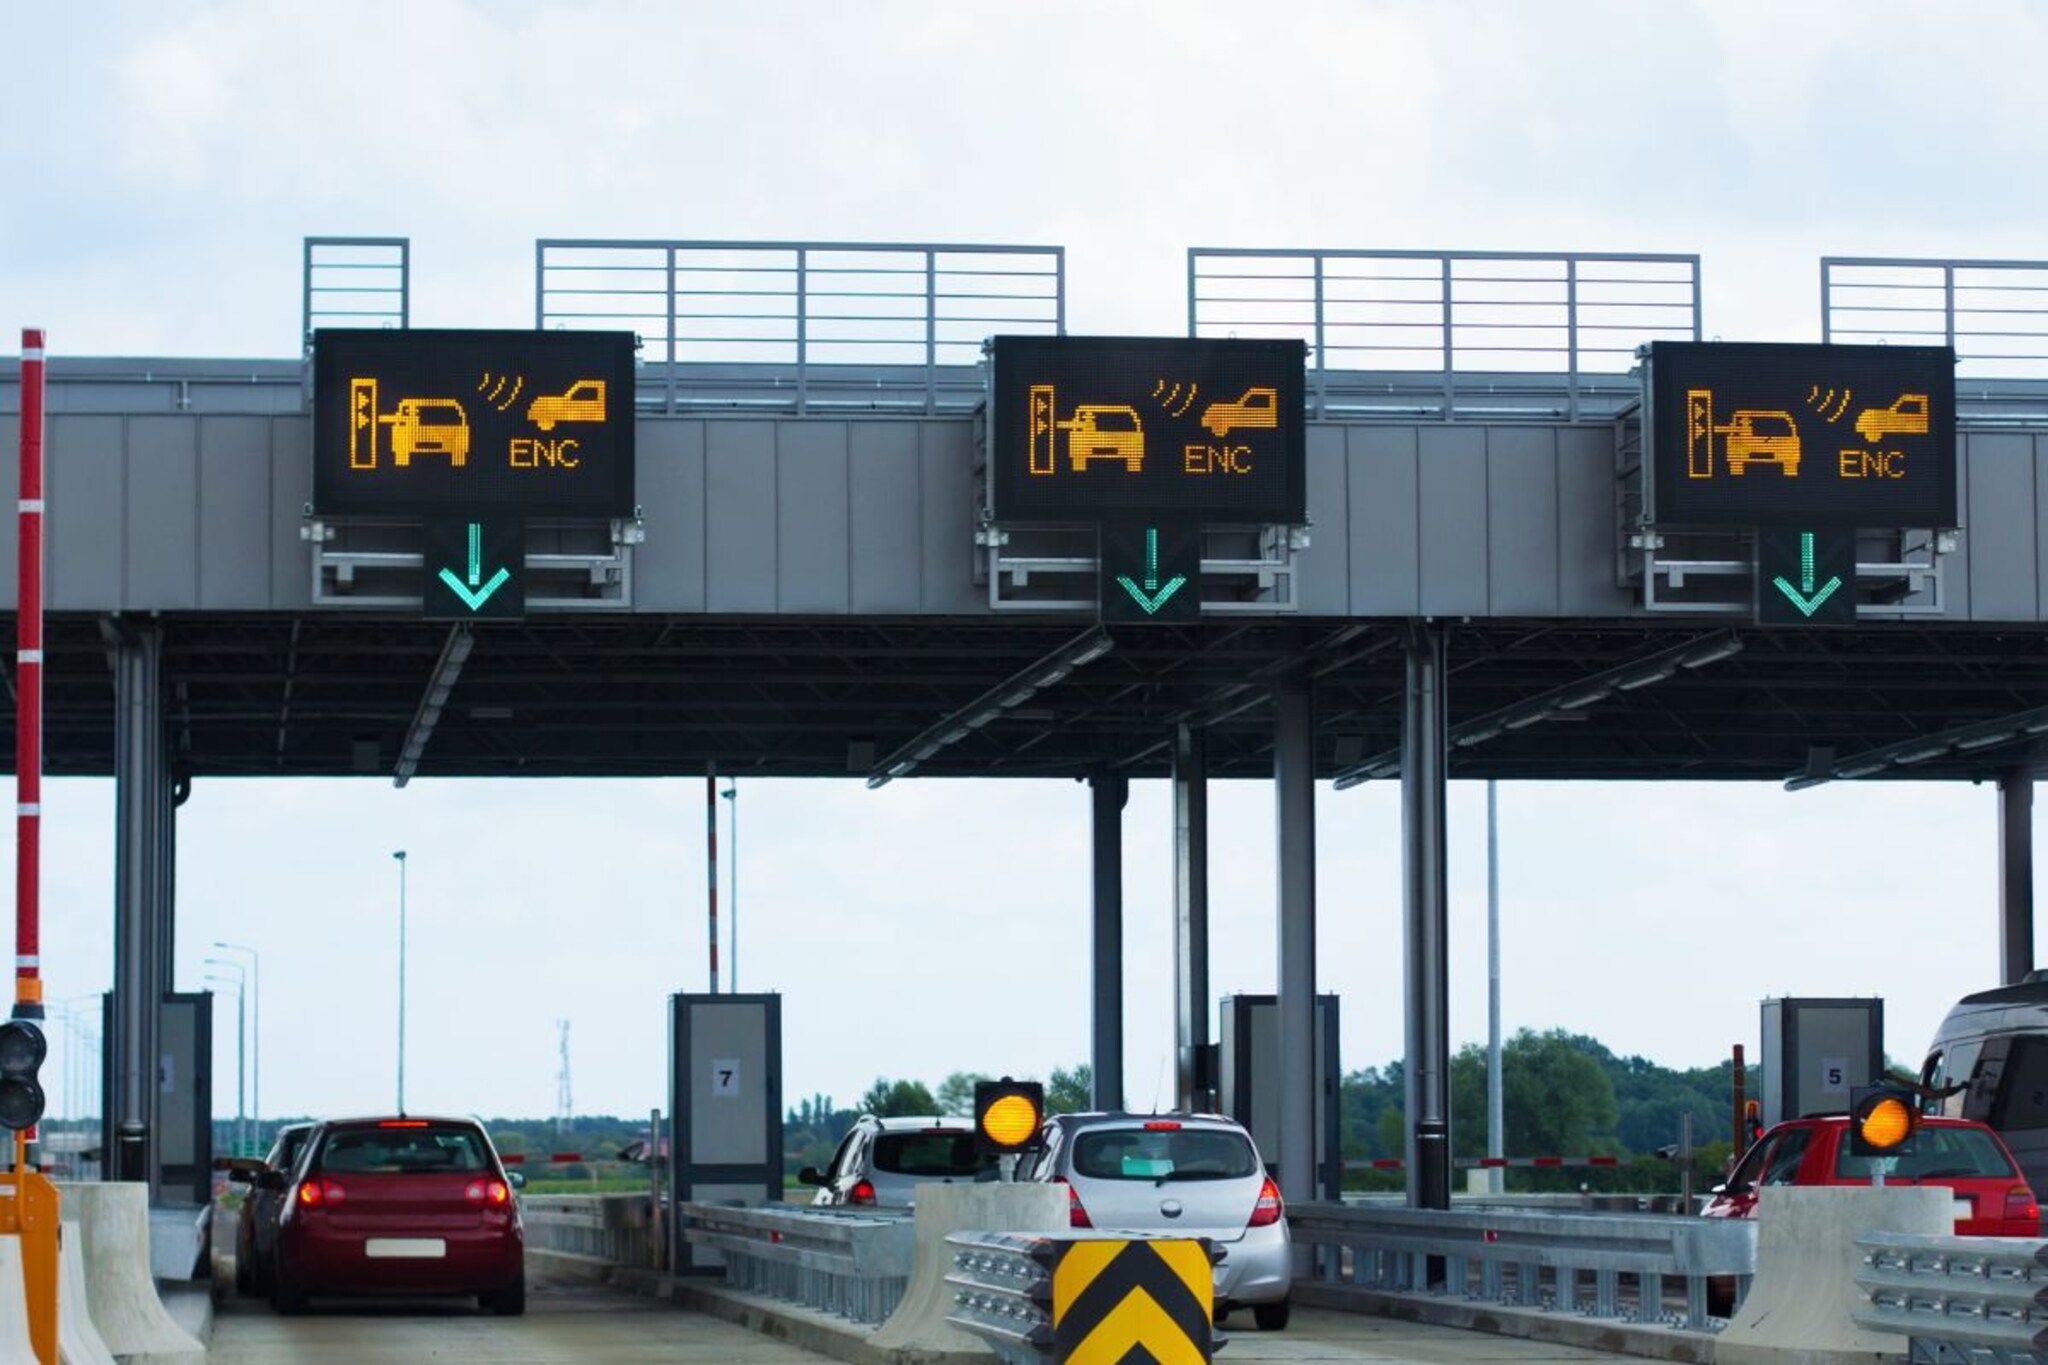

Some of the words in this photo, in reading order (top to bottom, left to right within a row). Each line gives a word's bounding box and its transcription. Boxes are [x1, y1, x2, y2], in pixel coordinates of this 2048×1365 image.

[510, 439, 579, 467] ENC
[1185, 446, 1251, 473] ENC
[1840, 450, 1904, 477] ENC
[719, 1070, 732, 1087] 7
[1829, 1068, 1842, 1085] 5
